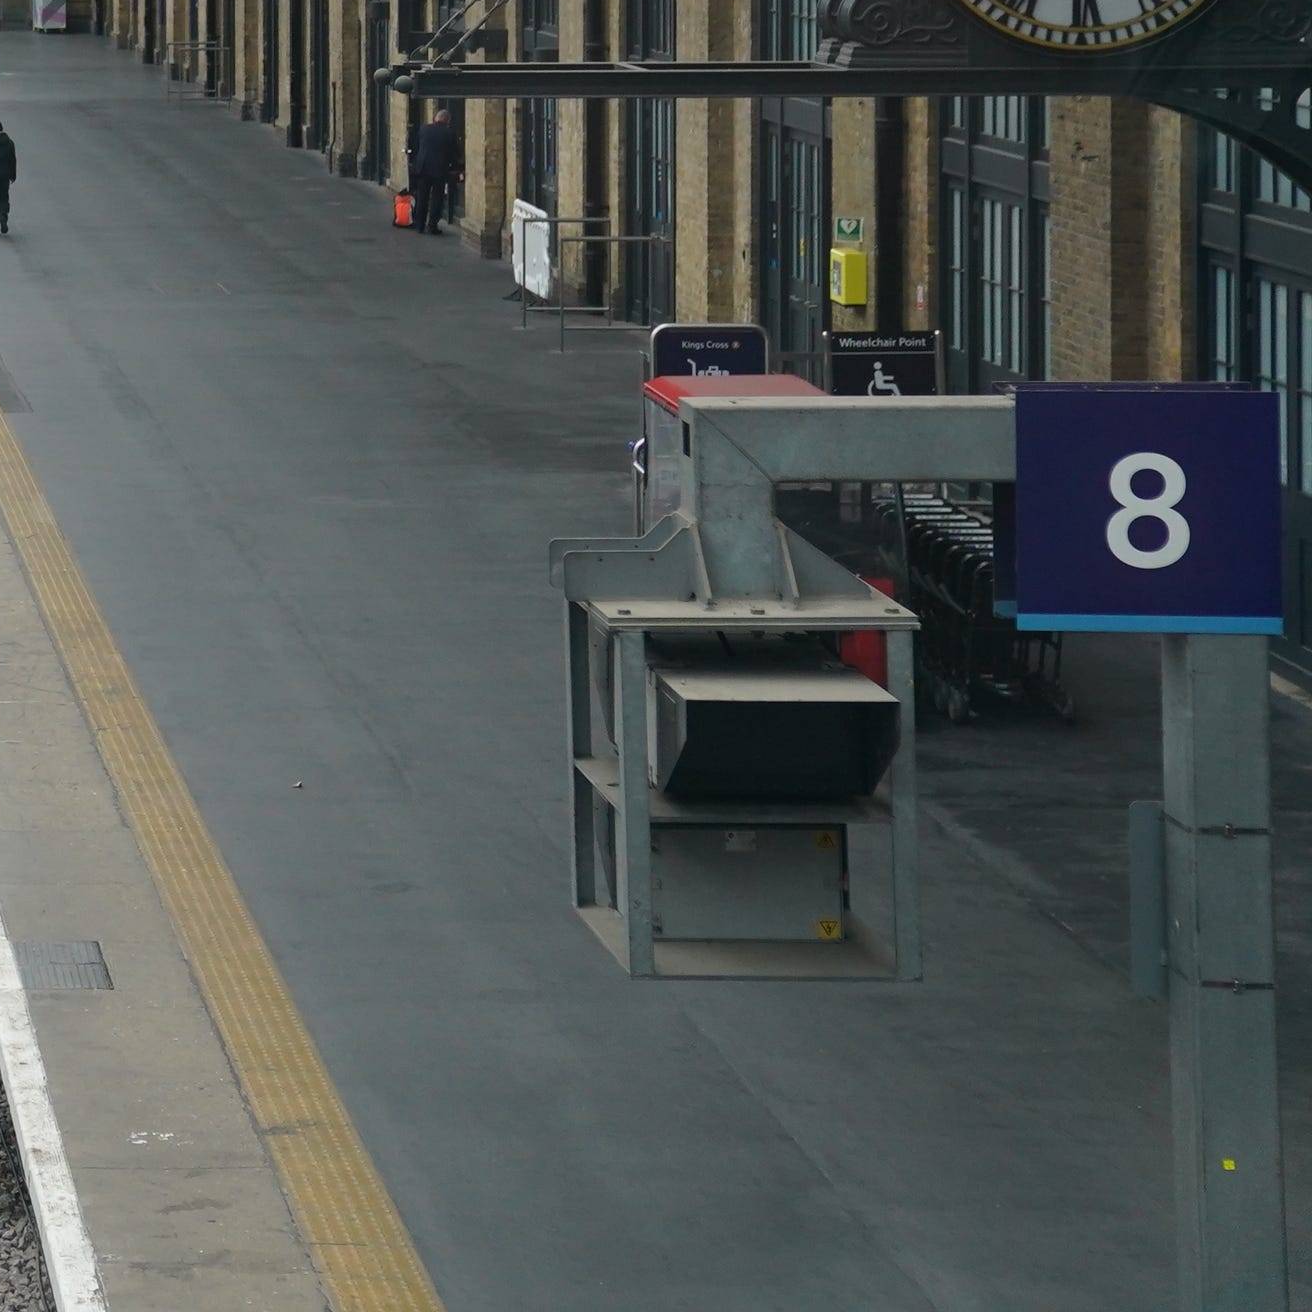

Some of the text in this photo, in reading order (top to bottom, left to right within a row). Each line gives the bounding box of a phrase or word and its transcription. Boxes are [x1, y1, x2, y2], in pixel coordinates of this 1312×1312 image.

[682, 340, 729, 350] Kings Cross
[839, 337, 926, 348] Wheelchair Point
[1105, 452, 1192, 570] 8
